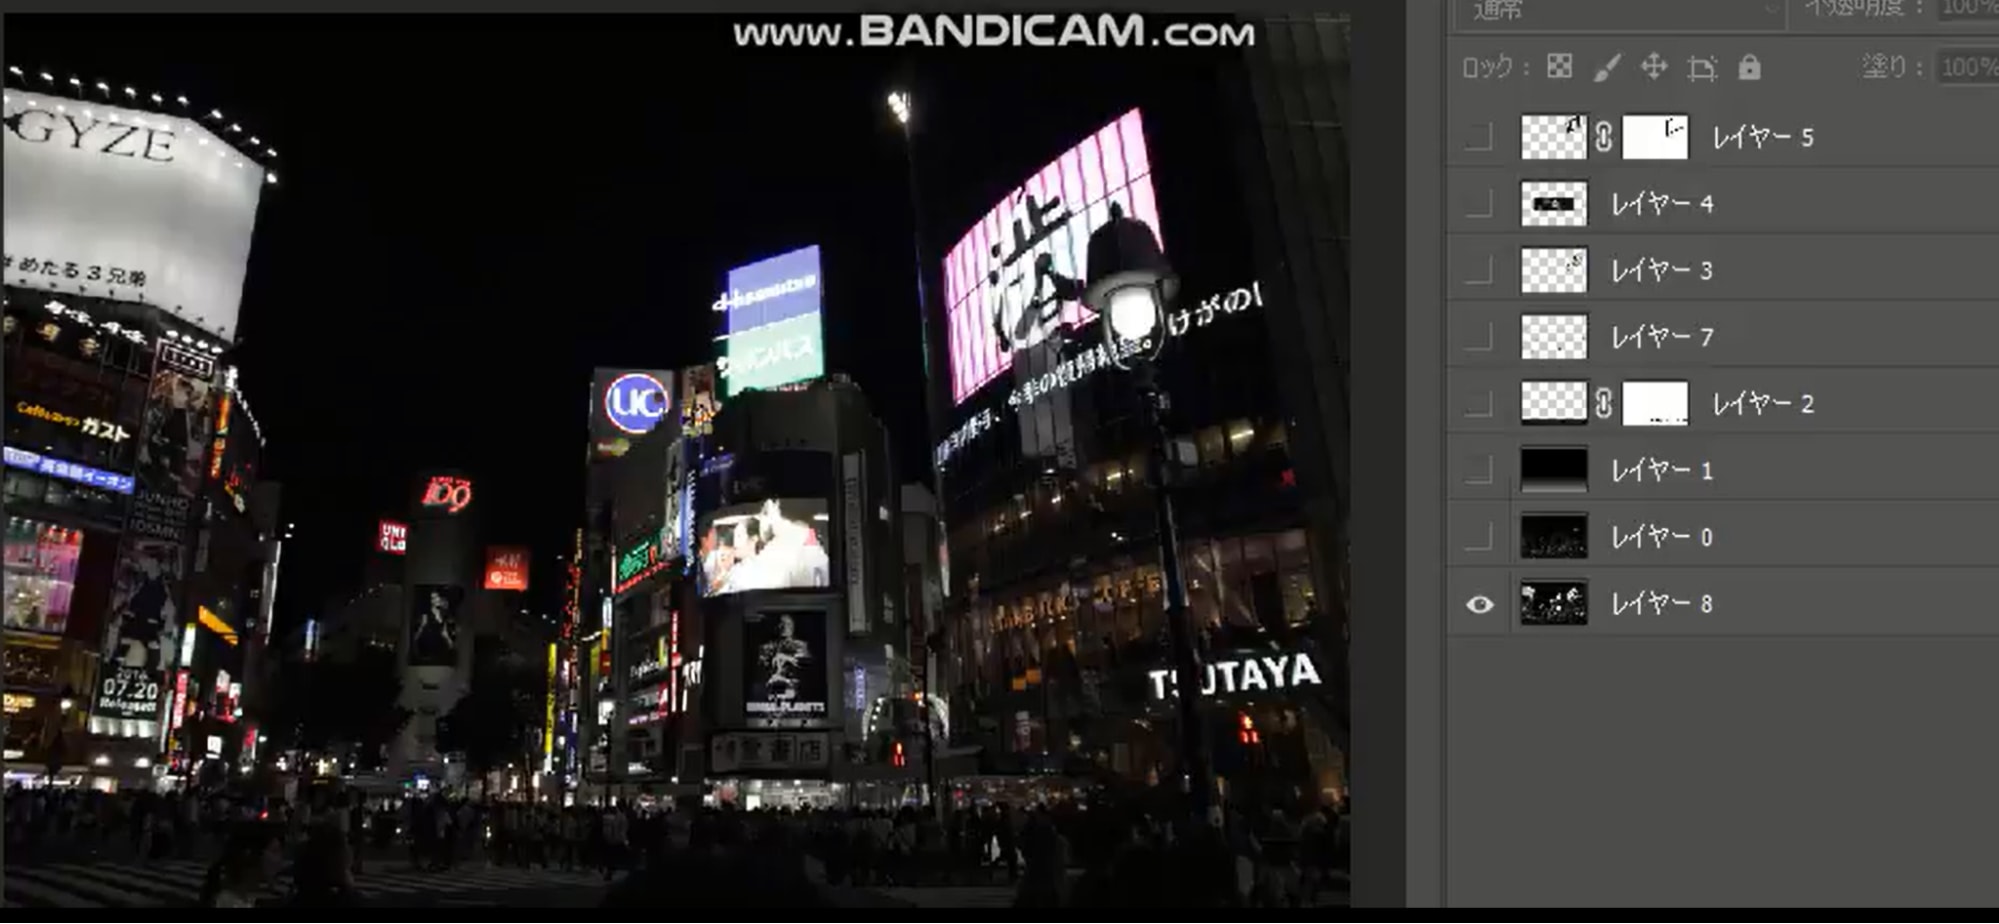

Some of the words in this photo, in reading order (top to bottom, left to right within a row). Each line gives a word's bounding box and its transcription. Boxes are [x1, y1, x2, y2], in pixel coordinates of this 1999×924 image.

[1474, 0, 1523, 21] 通常
[1714, 124, 1791, 150] レイヤー
[1800, 128, 1815, 148] 5
[1614, 190, 1691, 216] レイヤー
[1700, 194, 1715, 214] 4
[1612, 257, 1691, 283] レイヤー
[1700, 260, 1713, 281] 3
[1612, 324, 1691, 350] レイヤー
[1700, 327, 1715, 348] 7
[1714, 390, 1792, 416] レイヤー
[1801, 394, 1815, 414] 2
[81, 417, 131, 442] ガスト
[1612, 457, 1691, 483] レイヤー
[1702, 461, 1714, 481] 1
[1612, 523, 1691, 549] レイヤー
[1700, 527, 1713, 548] 0
[1612, 590, 1691, 616] レイヤー
[1700, 593, 1713, 614] 8
[103, 677, 158, 700] 07.20
